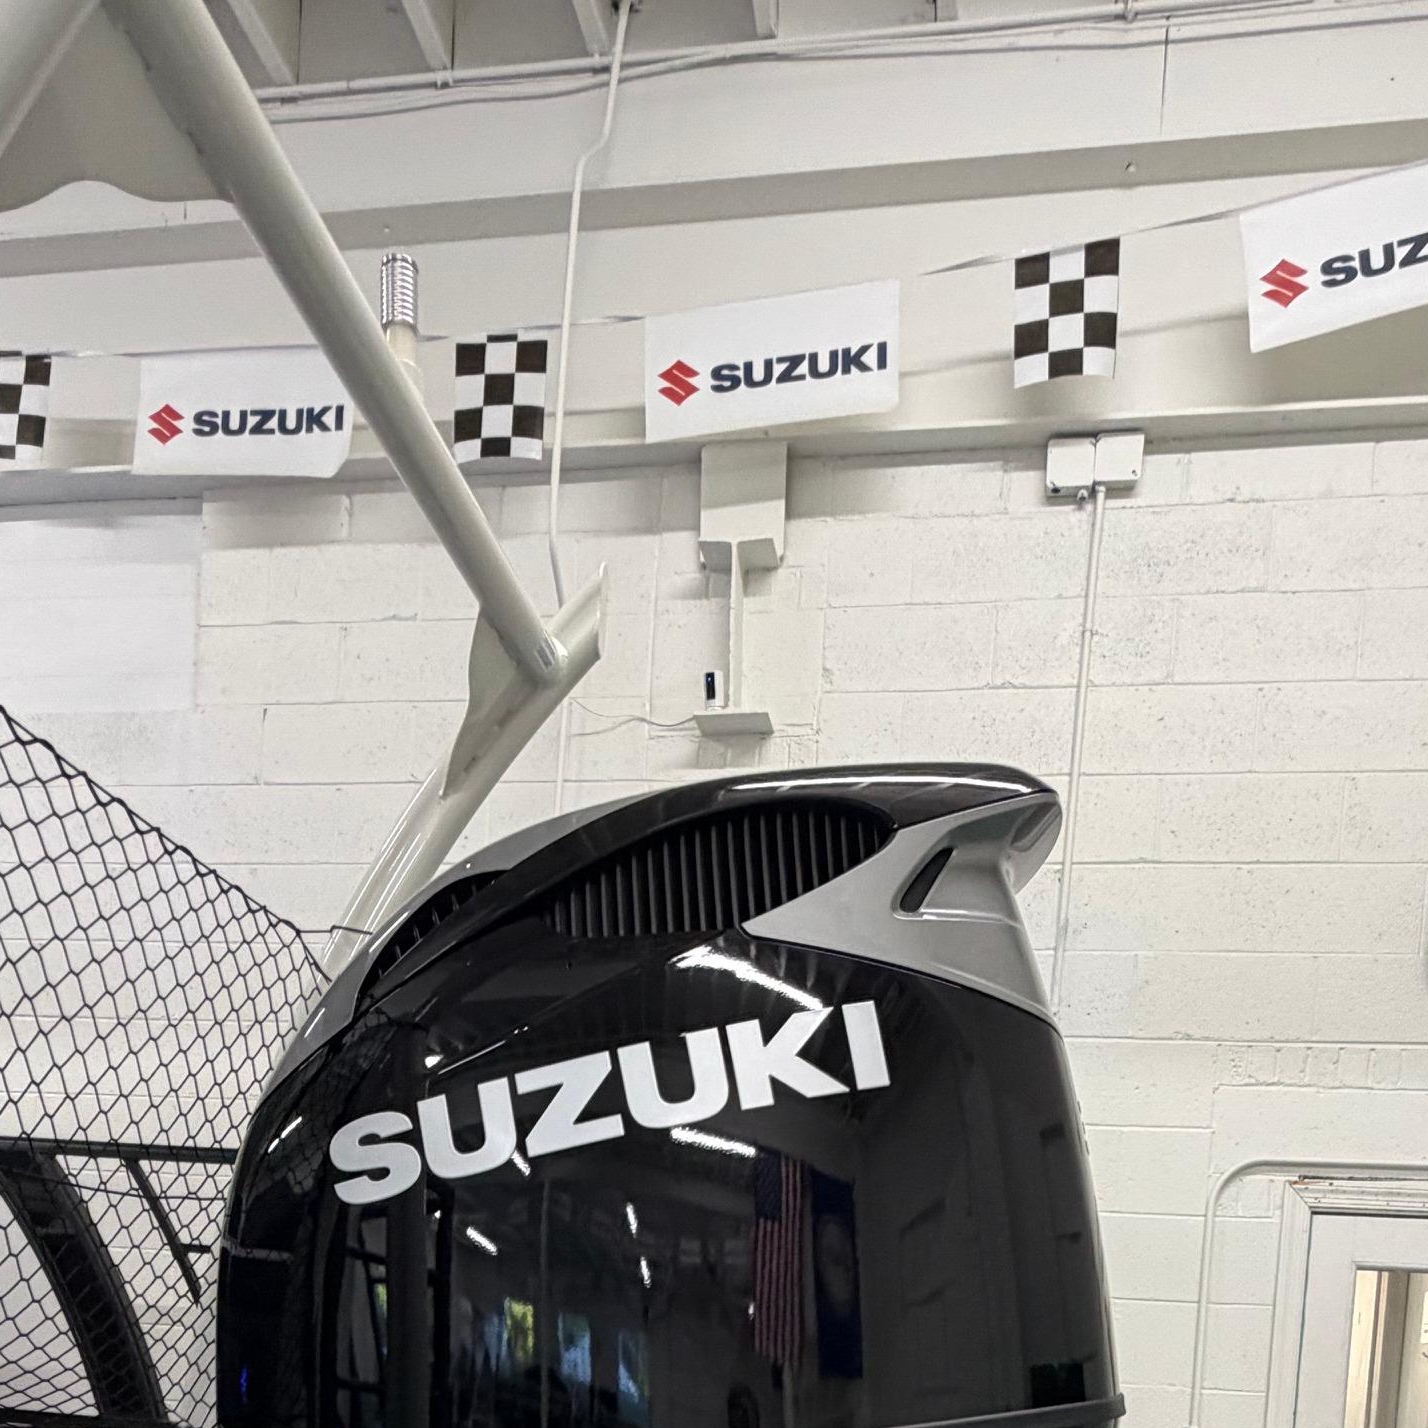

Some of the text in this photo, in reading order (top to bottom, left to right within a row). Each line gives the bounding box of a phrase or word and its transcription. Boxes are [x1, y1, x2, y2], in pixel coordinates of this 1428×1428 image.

[710, 341, 887, 393] SUZUKI
[192, 404, 345, 437] SUZUKI
[329, 1000, 890, 1205] SUZUKI
